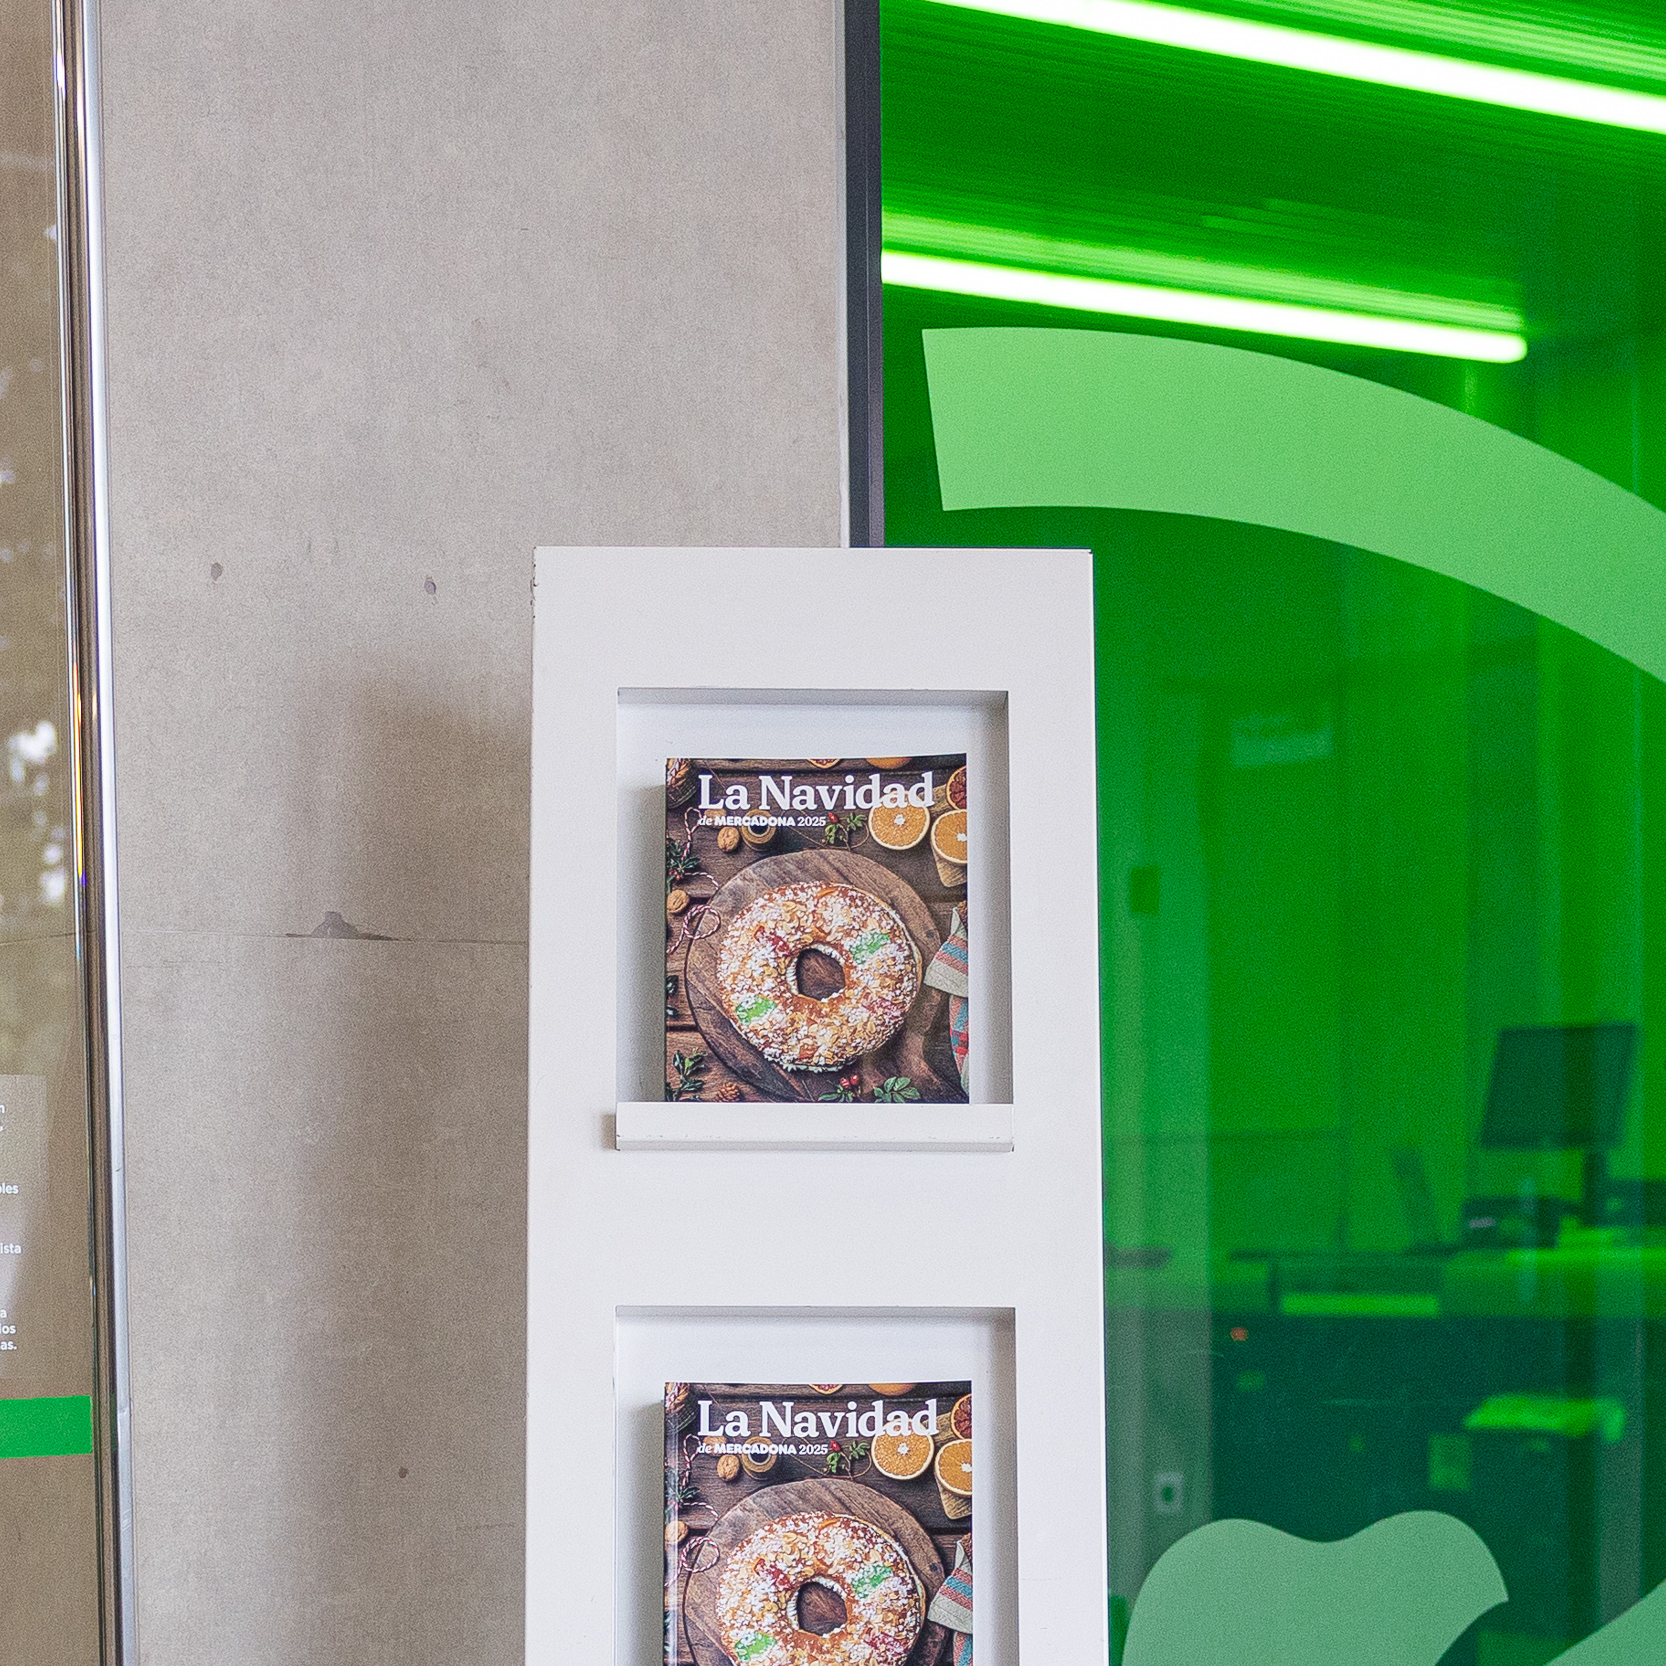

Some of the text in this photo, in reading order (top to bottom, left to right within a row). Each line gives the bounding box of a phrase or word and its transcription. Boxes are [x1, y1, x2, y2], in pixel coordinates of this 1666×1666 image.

[698, 771, 934, 810] La Navidad
[698, 816, 826, 827] de MERCADONA 2025
[698, 1399, 939, 1437] La Navidad
[697, 1444, 828, 1455] de MERCADONA 2025
